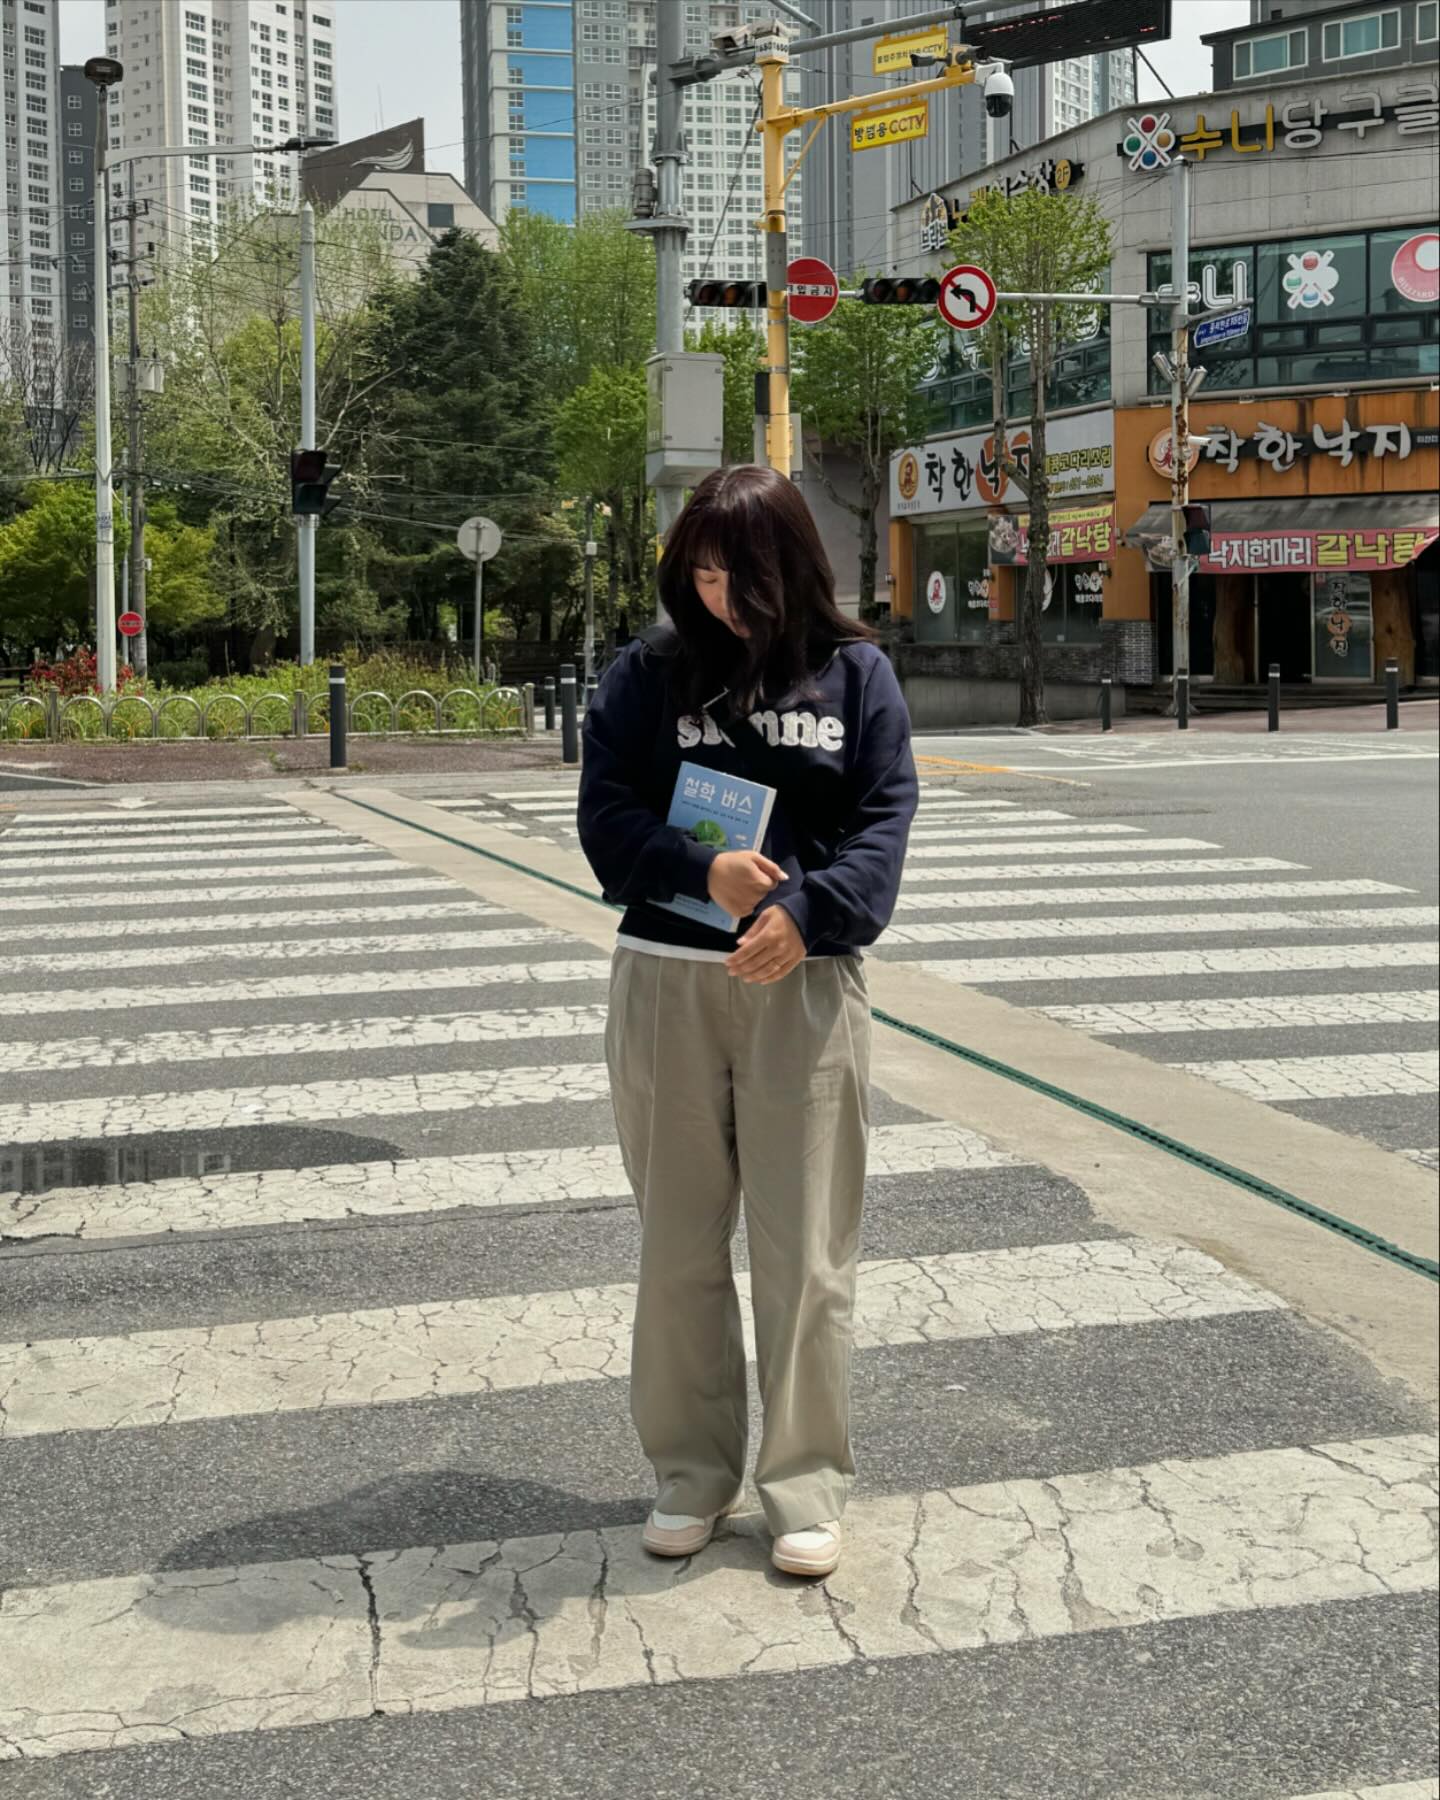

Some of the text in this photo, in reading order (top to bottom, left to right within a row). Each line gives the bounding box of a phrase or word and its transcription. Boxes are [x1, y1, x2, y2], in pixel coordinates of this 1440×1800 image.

[1205, 419, 1412, 473] 착한낙지
[1061, 521, 1112, 557] 갈낙탕
[1207, 537, 1312, 570] 낙지한마리
[683, 777, 716, 804] 철학
[720, 788, 753, 815] 버스
